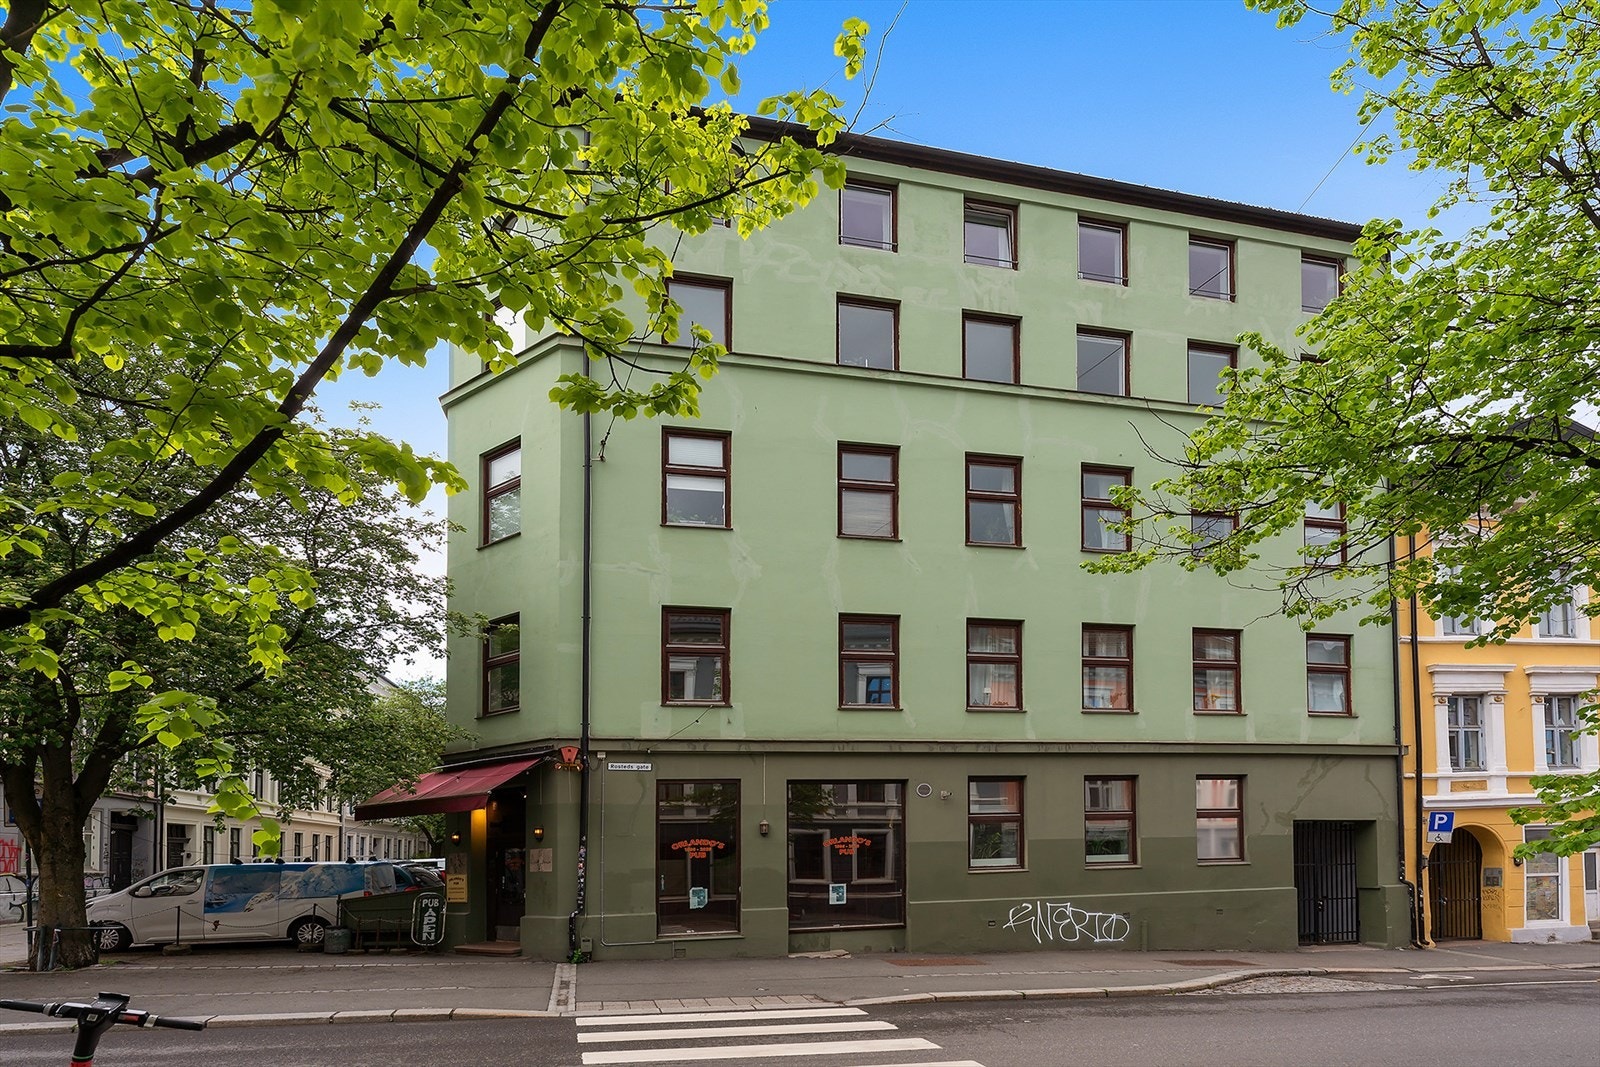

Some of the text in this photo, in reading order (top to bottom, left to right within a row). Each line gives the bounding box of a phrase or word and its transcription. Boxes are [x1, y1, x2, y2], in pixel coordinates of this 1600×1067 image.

[1434, 814, 1448, 829] P
[671, 839, 725, 849] ORLANDO'S
[823, 836, 871, 847] ORLANDO'S
[689, 851, 707, 859] PUB
[422, 899, 439, 907] PUB
